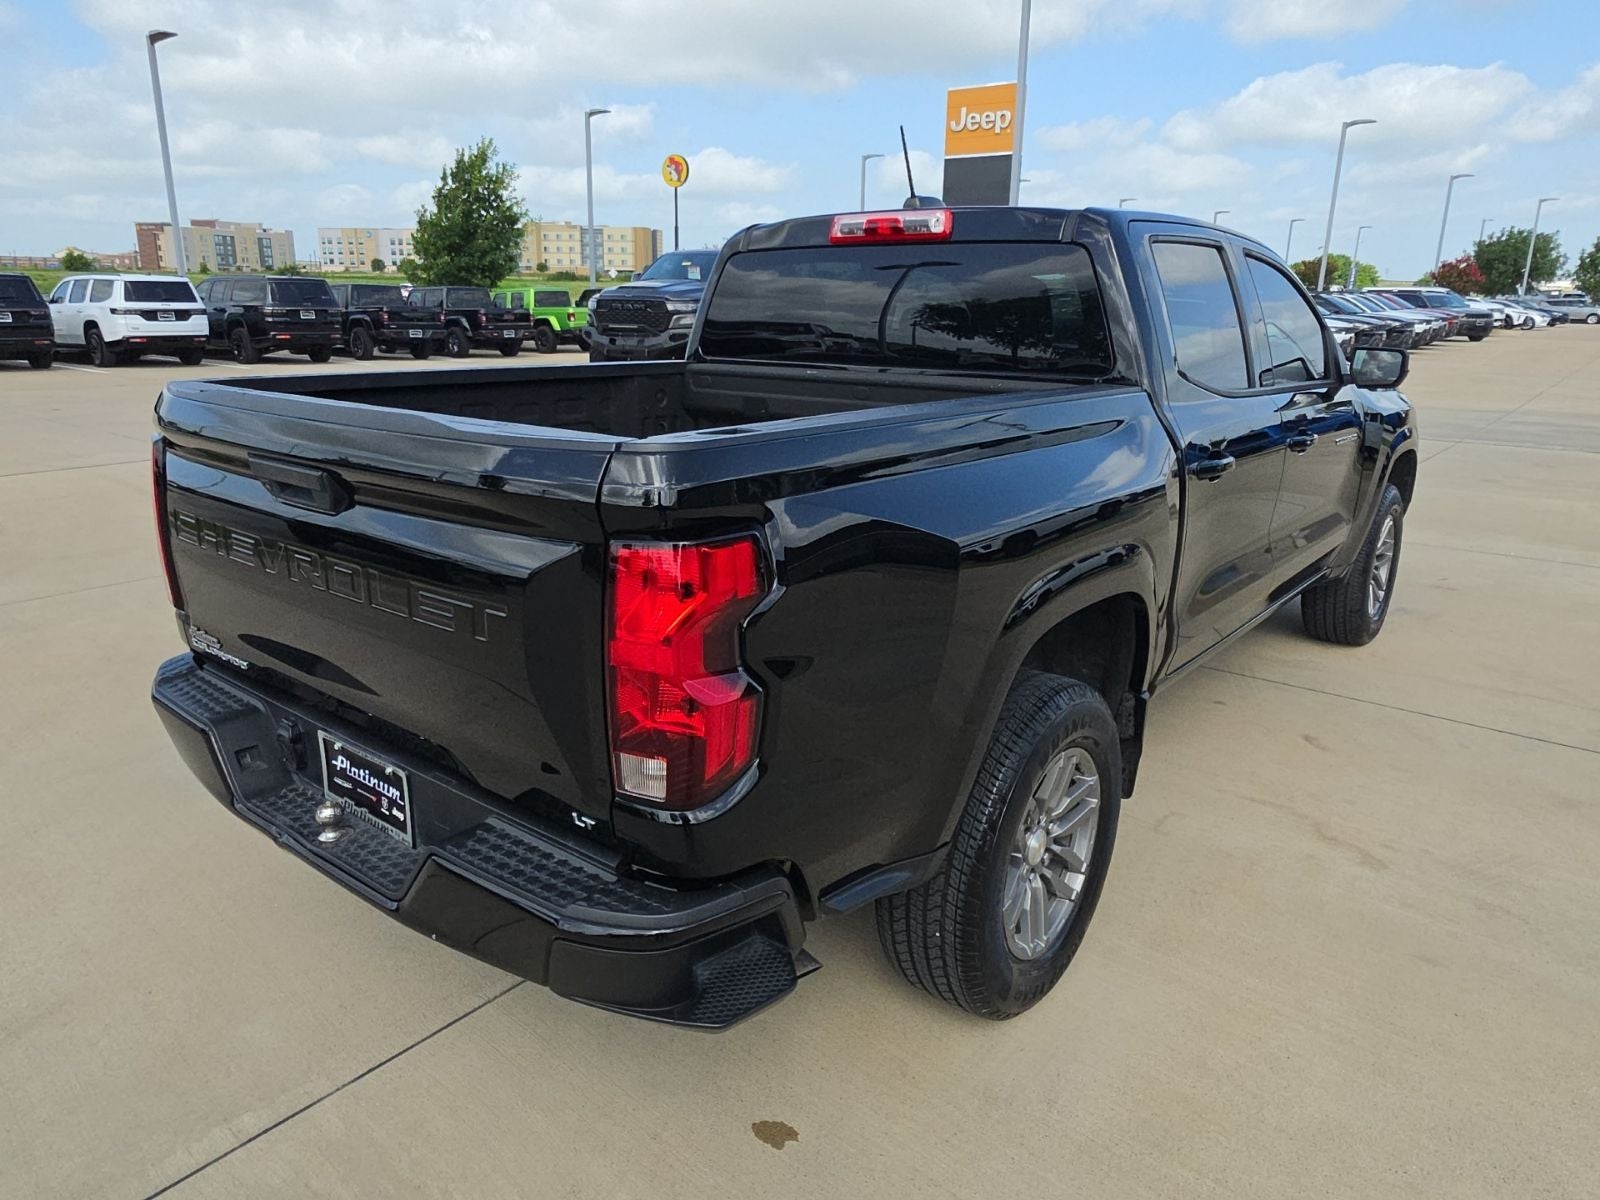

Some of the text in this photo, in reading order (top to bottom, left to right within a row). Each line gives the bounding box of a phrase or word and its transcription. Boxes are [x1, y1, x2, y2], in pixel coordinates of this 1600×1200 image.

[950, 106, 1012, 134] Jeep
[173, 508, 508, 642] CHEVROLET
[331, 754, 405, 806] Platinum
[571, 811, 596, 831] LT
